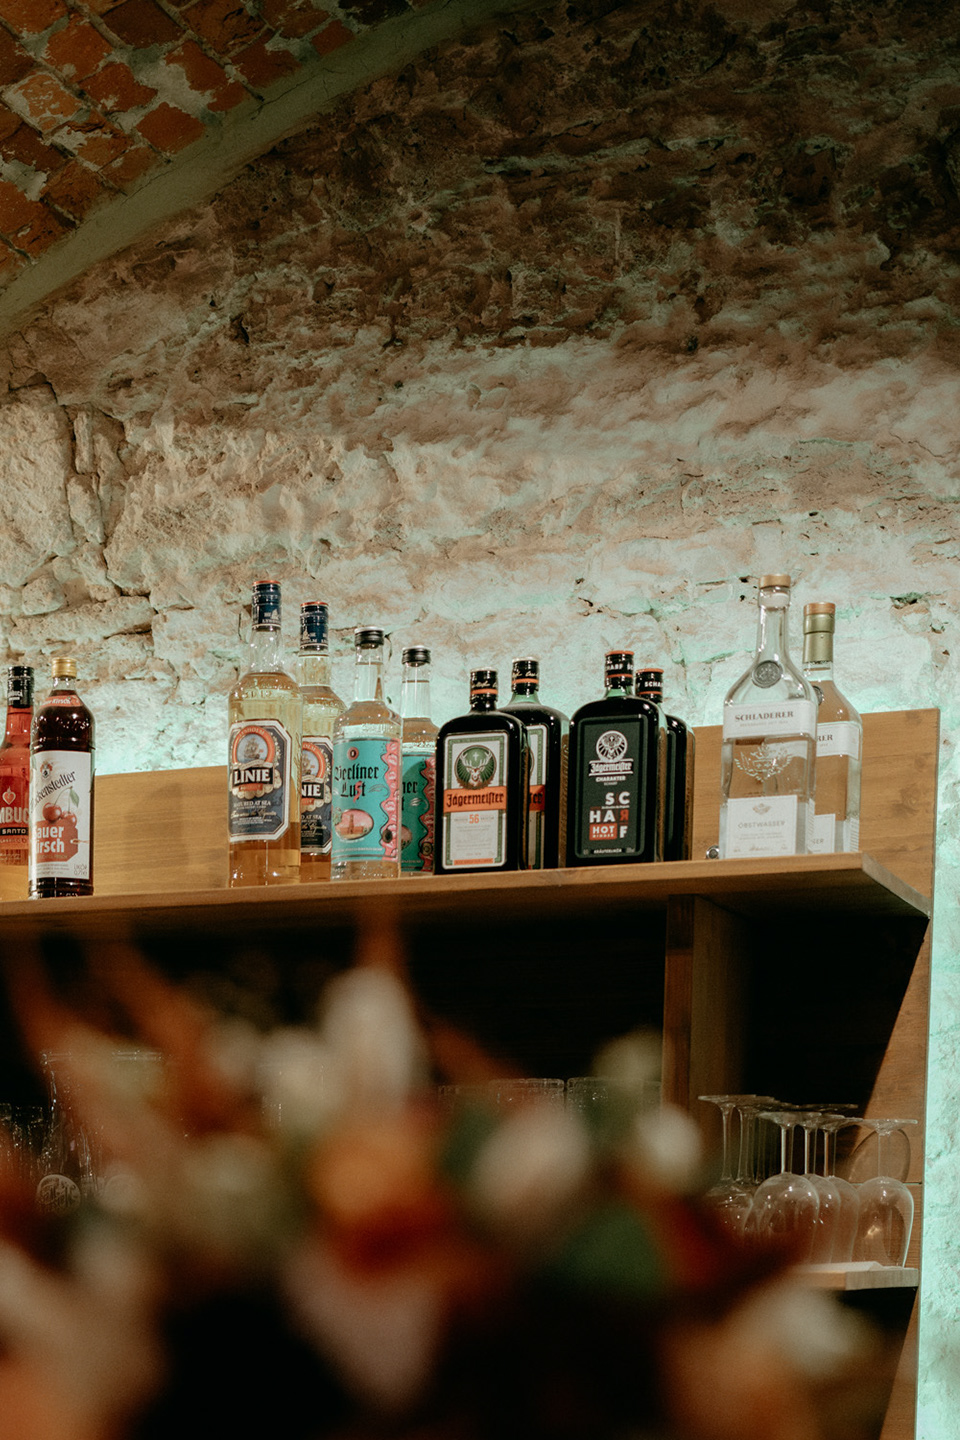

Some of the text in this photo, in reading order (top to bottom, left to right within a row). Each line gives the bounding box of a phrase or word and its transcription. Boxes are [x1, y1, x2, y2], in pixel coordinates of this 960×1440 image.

[735, 711, 793, 721] SCHLADERER
[234, 769, 271, 784] LINIE
[335, 764, 379, 781] Berliner
[447, 792, 504, 807] Jägermeister
[469, 814, 480, 824] 56
[37, 826, 65, 838] auer
[593, 825, 615, 834] HOT
[37, 838, 65, 853] irsch
